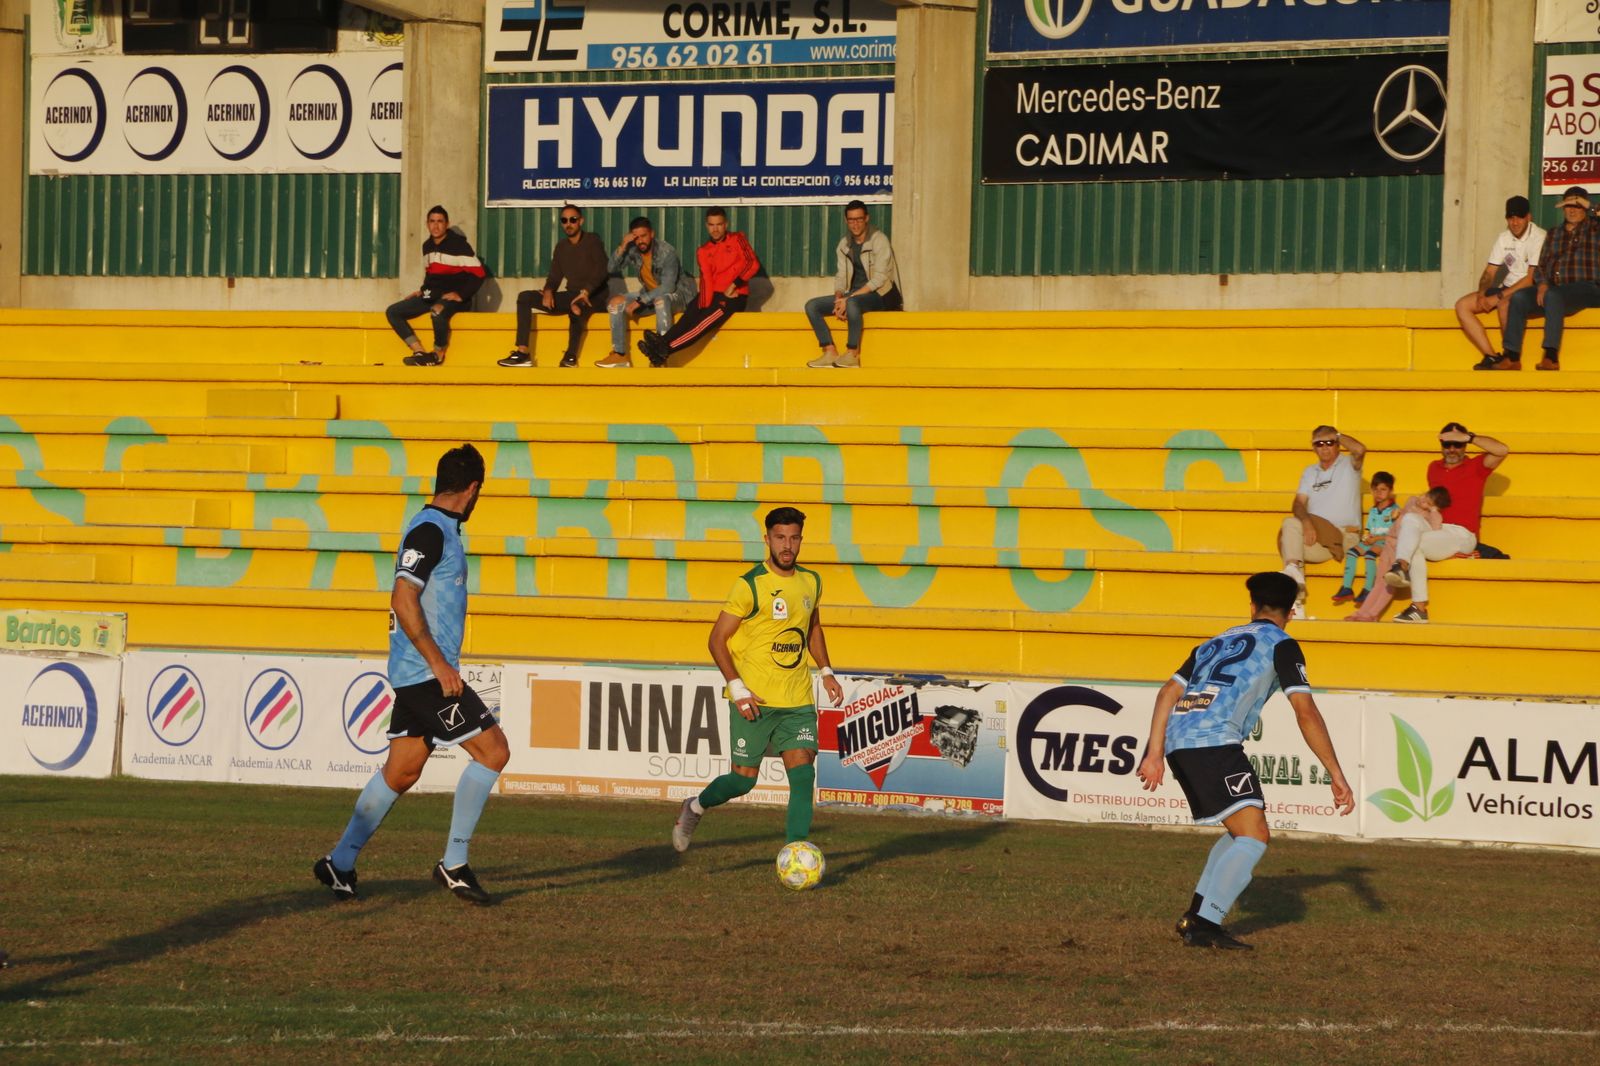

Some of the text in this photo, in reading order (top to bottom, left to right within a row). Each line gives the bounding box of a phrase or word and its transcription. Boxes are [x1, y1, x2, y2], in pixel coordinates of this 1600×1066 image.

[663, 0, 868, 40] CORIME, S.L.
[612, 46, 657, 69] 956
[666, 45, 698, 67] 62
[706, 44, 738, 66] 02
[747, 43, 773, 65] 61
[1016, 78, 1221, 114] Mercedes-Benz
[45, 106, 93, 125] ACERINOX
[126, 104, 173, 123] ACERINOX
[207, 103, 256, 122] ACERINOX
[289, 102, 338, 121] ACERINOX
[1546, 111, 1600, 136] ABO
[1015, 131, 1169, 167] CADIMAR
[1543, 160, 1594, 172] 956 621
[522, 178, 581, 189] ALGECIRAS
[593, 177, 610, 188] 956
[612, 177, 629, 188] 665
[631, 176, 647, 188] 167
[664, 176, 679, 187] LA
[722, 176, 738, 187] DE
[742, 176, 757, 186] LA
[760, 175, 830, 186] CONCEPCION
[844, 175, 861, 186] 956
[863, 175, 880, 186] 643
[6, 615, 81, 647] Barrios
[1187, 632, 1257, 688] 22
[22, 703, 83, 729] ACERINOX
[588, 681, 727, 755] INNA
[837, 692, 924, 760] MIGUEL
[131, 752, 213, 767] Academia ANCAR
[229, 756, 312, 771] Academia ANCAR
[842, 751, 866, 767] CENTRO
[1039, 732, 1138, 775] MES
[1457, 736, 1600, 787] ALM
[327, 760, 372, 773] Academia
[505, 780, 566, 792] INFRAESTRUCTURAS
[578, 784, 600, 794] OBRAS
[1073, 793, 1166, 808] DISTRIBUIDOR
[1169, 798, 1187, 809] DE
[1467, 793, 1594, 820] Vehículos
[1120, 812, 1133, 822] los
[1134, 811, 1166, 824] Álamos
